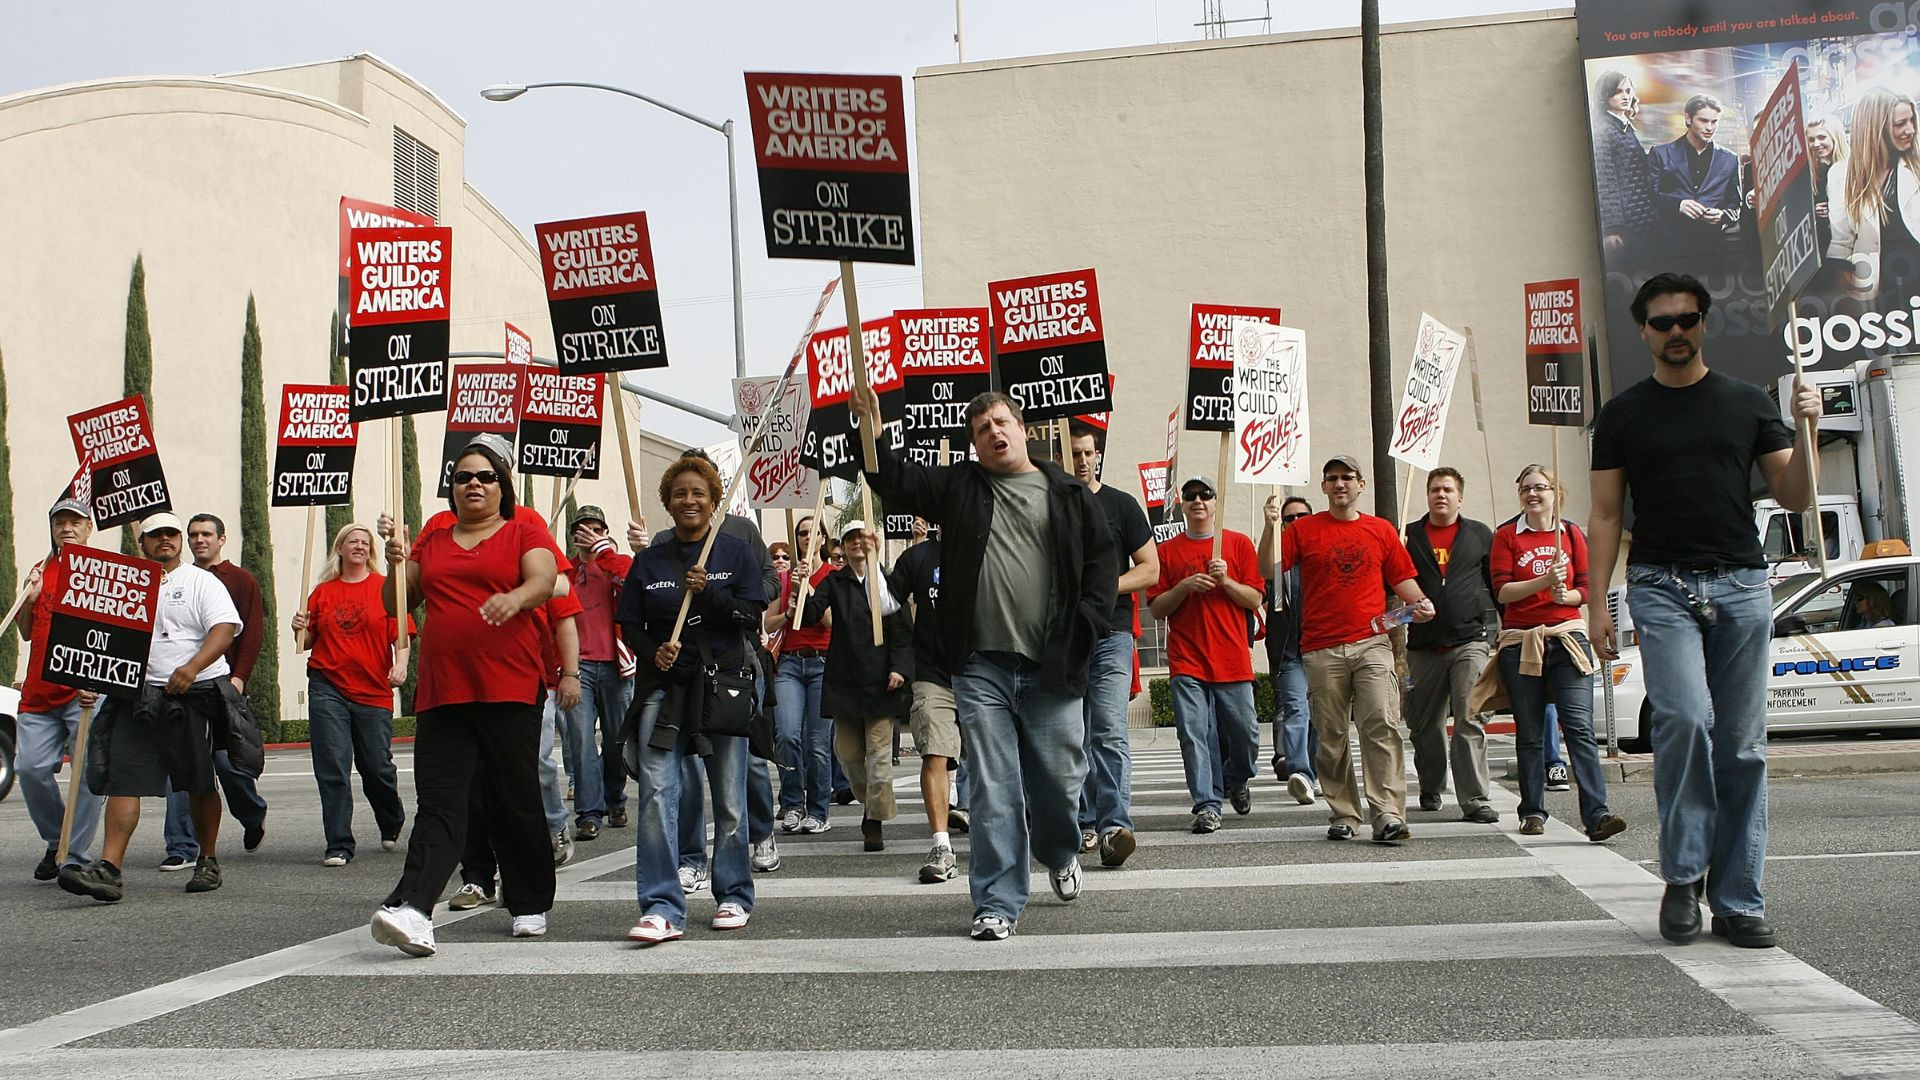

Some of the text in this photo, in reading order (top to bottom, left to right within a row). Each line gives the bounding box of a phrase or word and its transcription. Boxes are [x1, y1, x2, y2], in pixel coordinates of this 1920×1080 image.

[1604, 10, 1859, 43] You are nobody until you are talked about.
[757, 84, 887, 113] WRITERS
[767, 109, 887, 137] GUILD OF
[1753, 83, 1795, 165] WRITERS
[765, 134, 898, 161] AMERICA
[1757, 127, 1784, 184] GUILD
[1758, 133, 1802, 220] AMERICA
[816, 181, 849, 208] ON
[544, 223, 638, 251] WRITERS
[773, 208, 905, 250] STRIKE
[1774, 206, 1788, 245] ON
[357, 240, 442, 265] WRITERS
[553, 247, 639, 271] GUILD OF
[1766, 213, 1813, 313] STRIKE
[361, 265, 440, 289] GUILD OF
[552, 263, 649, 291] AMERICA
[357, 287, 445, 314] AMERICA
[997, 281, 1087, 309] WRITERS
[1528, 289, 1574, 310] WRITERS
[591, 304, 616, 326] ON
[901, 317, 979, 335] WRITERS
[1004, 302, 1087, 325] GUILD OF
[1531, 310, 1574, 327] GUILD OF
[905, 334, 978, 351] GUILD OF
[1002, 316, 1096, 344] AMERICA
[1528, 327, 1578, 345] AMERICA
[388, 335, 411, 361] ON
[562, 325, 660, 364] STRIKE
[873, 349, 891, 365] OF
[902, 350, 984, 367] AMERICA
[1040, 355, 1063, 377] ON
[1266, 358, 1280, 370] THE
[1432, 353, 1441, 366] THE
[355, 361, 443, 407] STRIKE
[457, 373, 517, 390] WRITERS
[528, 373, 596, 391] WRITERS
[1238, 366, 1288, 394] WRITERS
[1414, 355, 1443, 388] WRITERS
[1544, 362, 1558, 382] ON
[457, 390, 513, 407] GUILD OF
[530, 387, 594, 405] GUILD OF
[932, 382, 953, 400] ON
[1010, 373, 1106, 411] STRIKE
[1237, 391, 1278, 415] GUILD
[1407, 377, 1430, 404] GUILD
[1530, 385, 1581, 414] STRIKE
[74, 405, 139, 436] WRITERS
[289, 408, 336, 423] GUILD
[451, 407, 514, 424] AMERICA
[526, 400, 597, 418] AMERICA
[905, 402, 970, 430] STRIK
[82, 424, 141, 450] GUILD OF
[283, 424, 353, 438] AMERICA
[550, 428, 569, 444] ON
[85, 435, 150, 463] AMERICA
[306, 453, 326, 470] ON
[523, 444, 595, 470] STRIKE
[113, 469, 131, 488] ON
[277, 472, 349, 497] STRIKE
[96, 480, 166, 520] STRIKE
[68, 554, 151, 587] WRITERS
[705, 572, 728, 581] GUILD
[69, 573, 147, 604] GUILD OF
[61, 590, 148, 622] AMERICA
[86, 629, 111, 651] ON
[50, 645, 141, 688] STRIKE
[1772, 655, 1900, 677] POLICE
[1767, 698, 1817, 709] NFORCEMENT
[1773, 688, 1805, 698] PARKING
